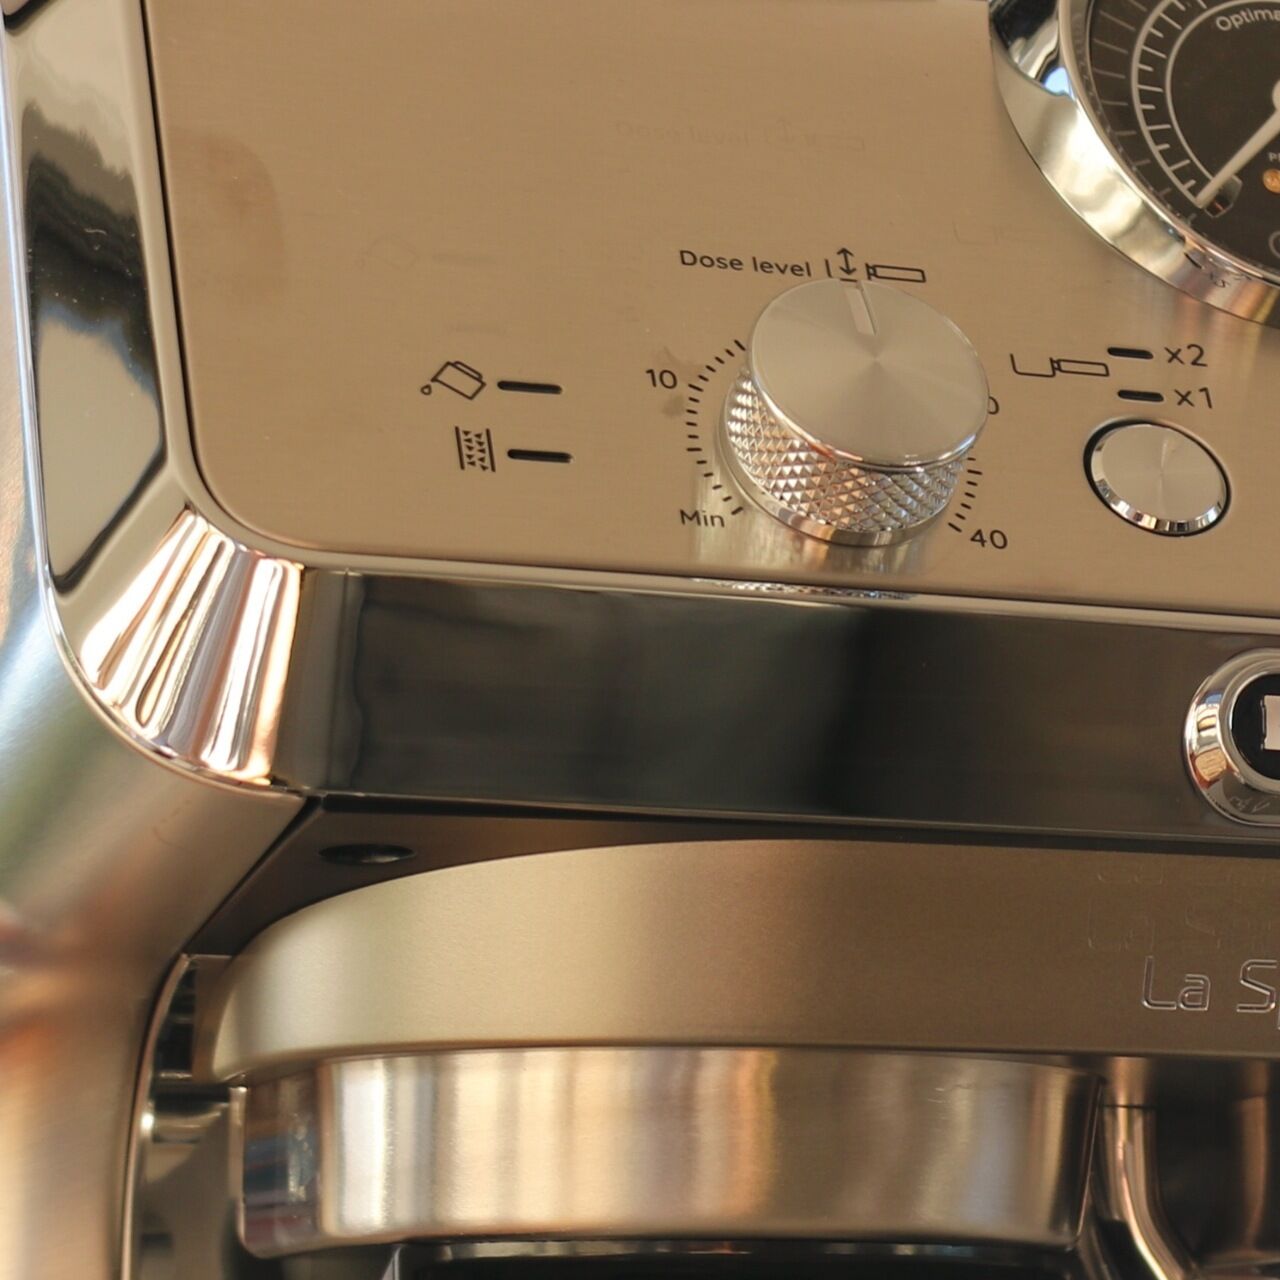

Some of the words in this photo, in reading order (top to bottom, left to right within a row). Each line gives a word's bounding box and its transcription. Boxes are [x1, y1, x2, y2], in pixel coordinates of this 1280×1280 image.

[679, 249, 744, 271] Dose
[752, 256, 812, 277] level
[1165, 344, 1208, 367] x2
[646, 368, 678, 390] 10
[1174, 387, 1214, 410] x1
[680, 509, 725, 529] Min
[971, 528, 1008, 550] 40
[1141, 956, 1211, 1011] La
